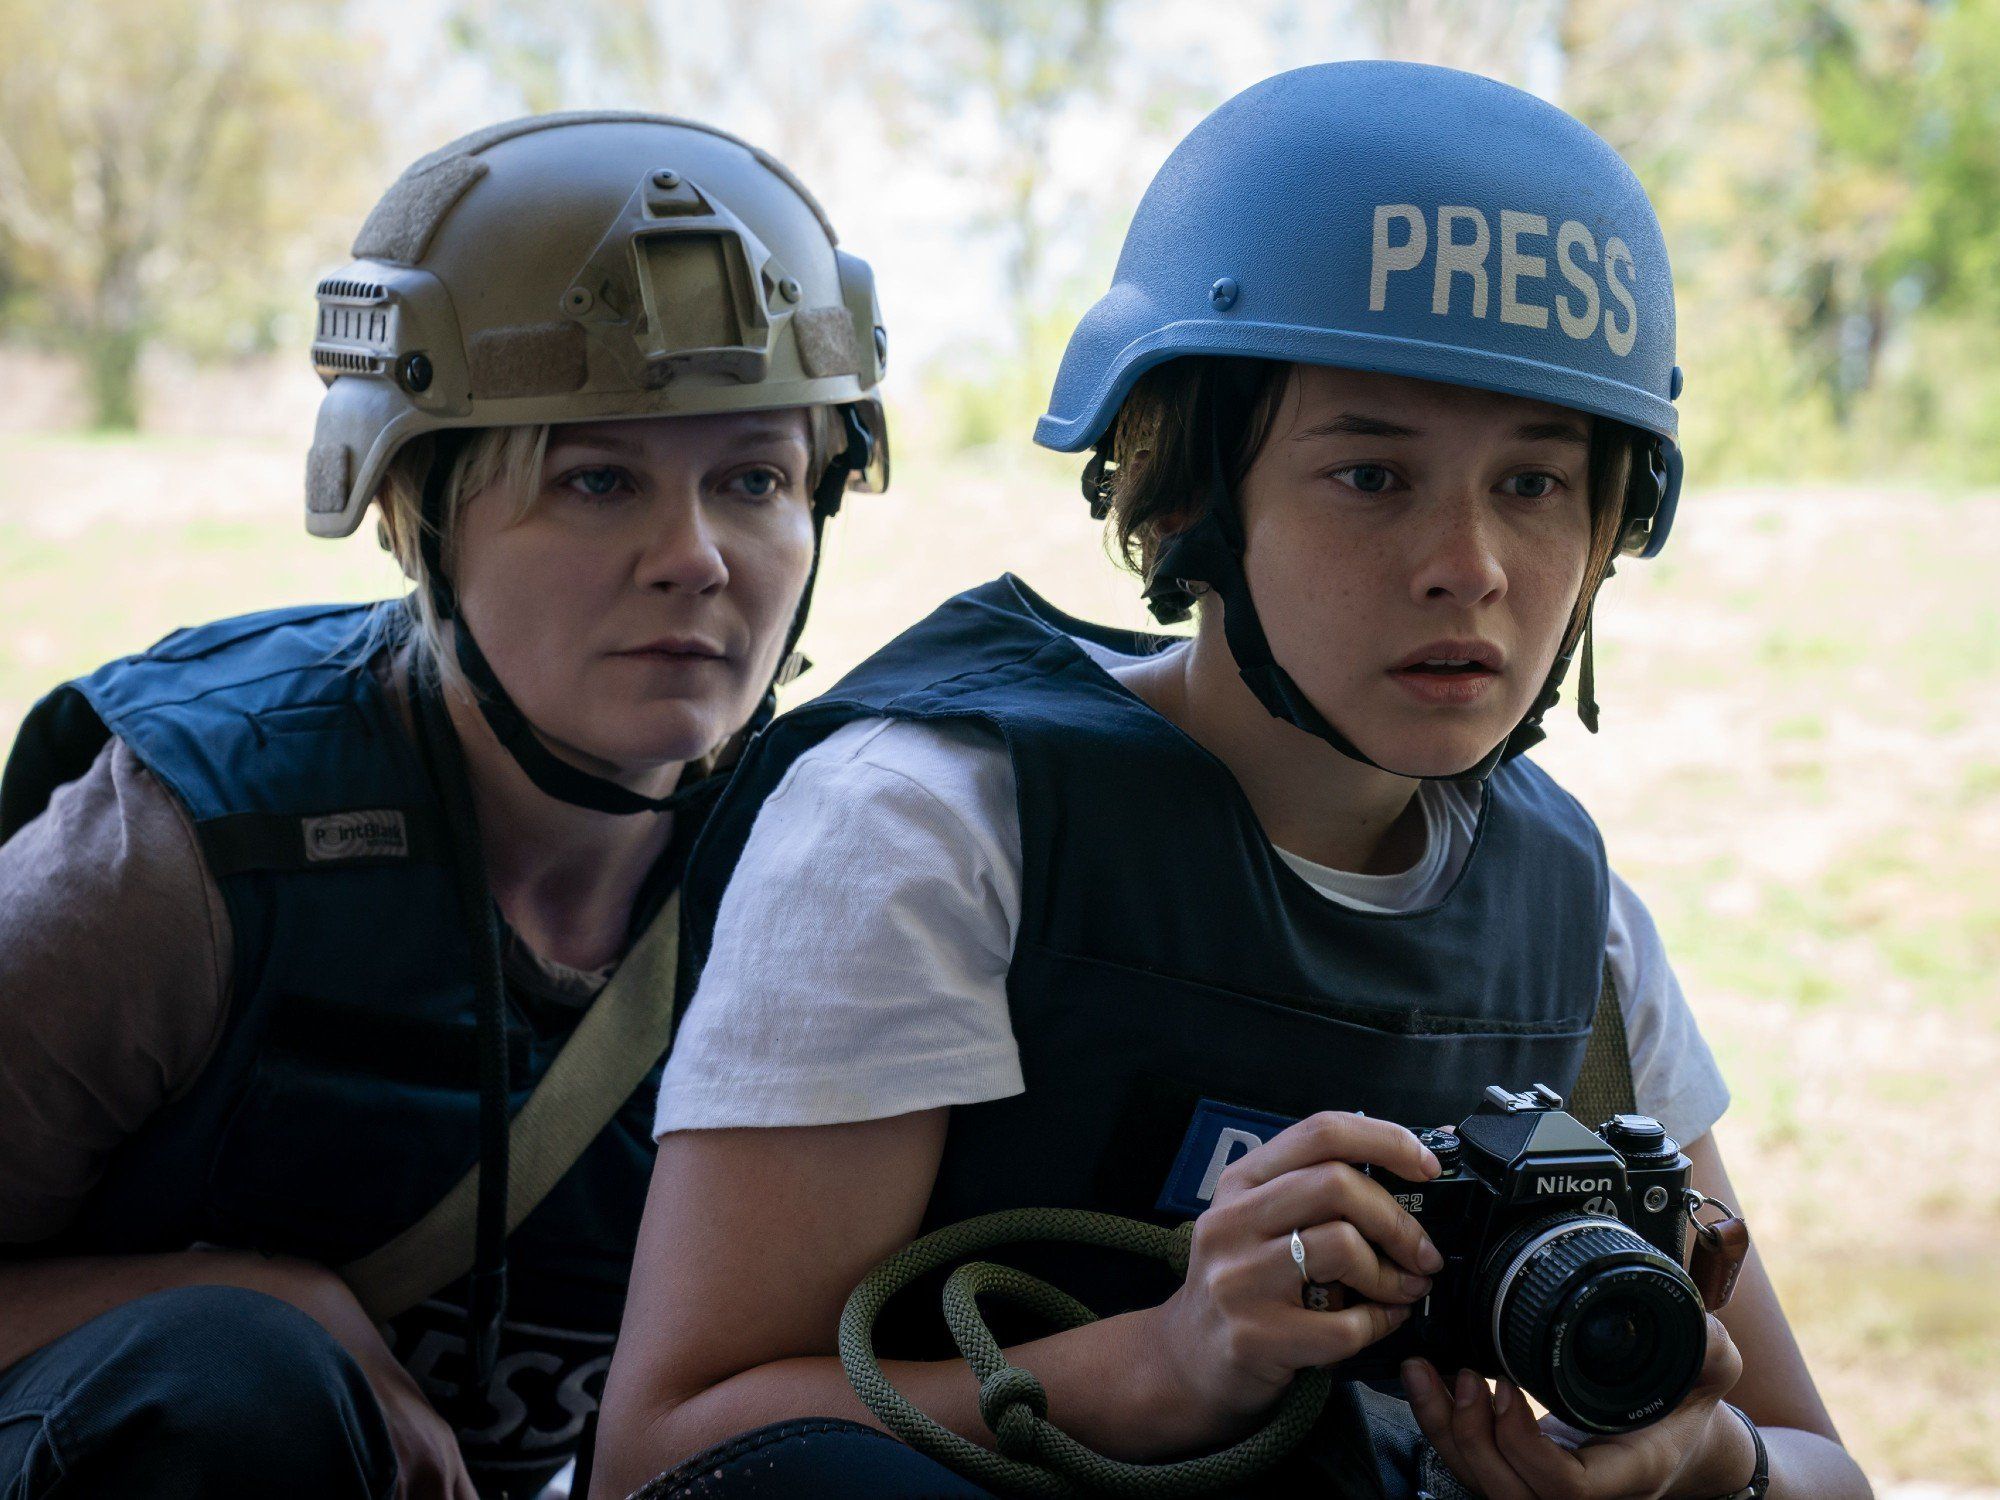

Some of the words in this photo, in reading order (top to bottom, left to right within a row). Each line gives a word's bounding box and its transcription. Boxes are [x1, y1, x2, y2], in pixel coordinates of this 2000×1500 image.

[1368, 203, 1638, 357] PRESS
[1536, 1174, 1613, 1196] Nikon
[388, 1322, 612, 1447] ESS
[1628, 1398, 1664, 1420] Nikon
